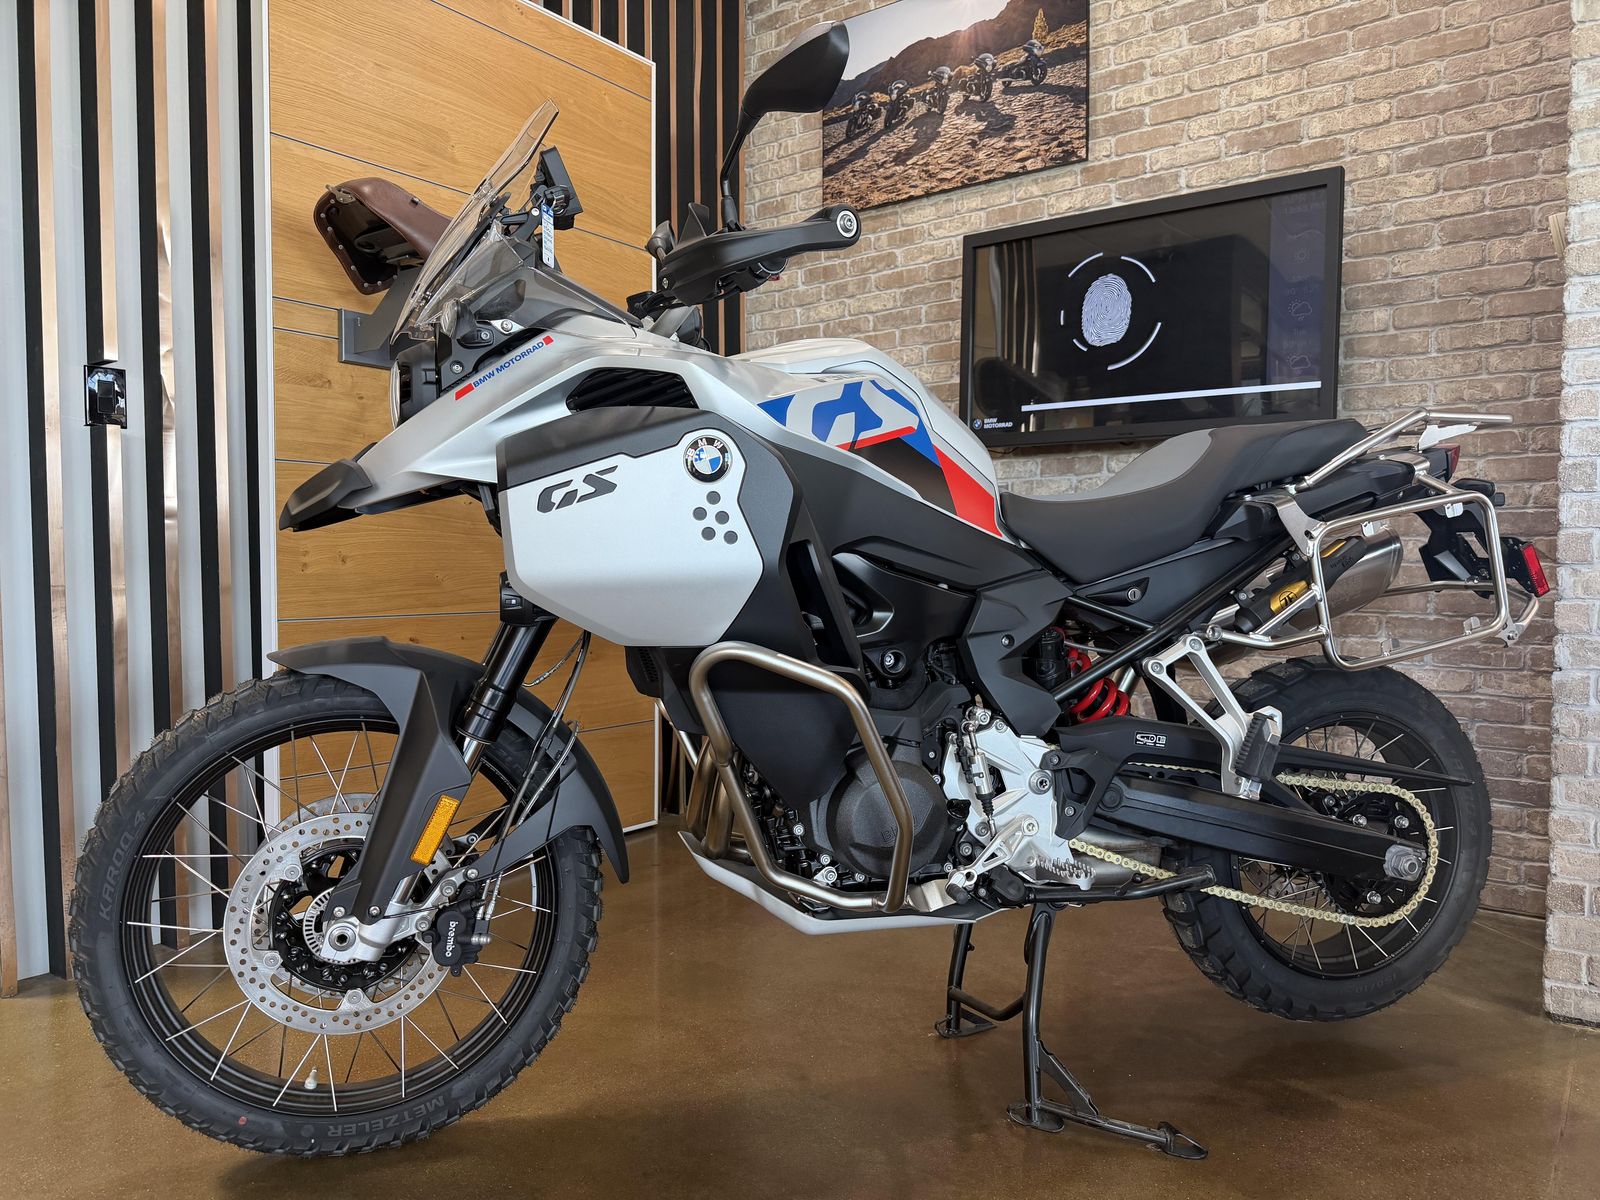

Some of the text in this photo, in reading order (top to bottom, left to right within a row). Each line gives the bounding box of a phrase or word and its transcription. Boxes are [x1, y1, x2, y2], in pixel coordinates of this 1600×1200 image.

[473, 341, 545, 388] BMW MOTORRAD
[983, 421, 1013, 429] MOTORRAD
[686, 438, 724, 460] BMW
[536, 464, 618, 514] GS
[98, 810, 146, 921] KAROO 4
[445, 921, 459, 958] brembo
[327, 1095, 445, 1137] METZELER
